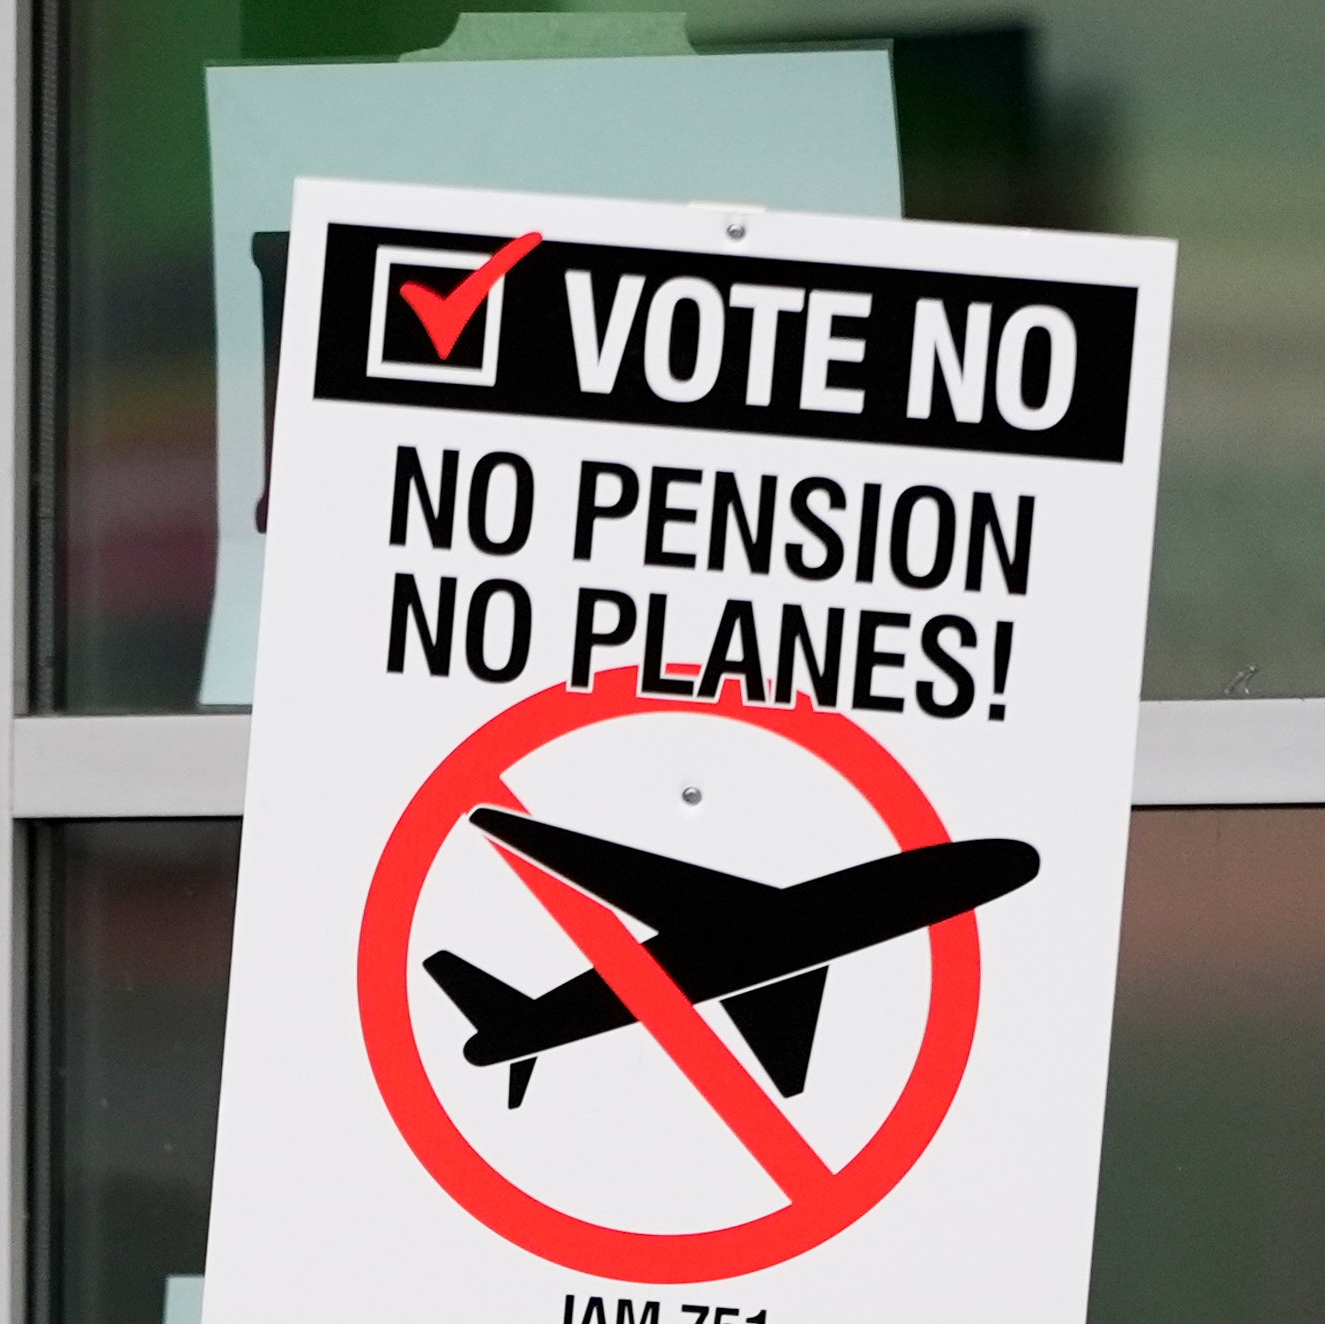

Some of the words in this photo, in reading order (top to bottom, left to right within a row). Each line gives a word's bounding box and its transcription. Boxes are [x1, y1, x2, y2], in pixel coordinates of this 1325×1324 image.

[564, 271, 872, 415] VOTE
[906, 298, 1078, 432] NO
[389, 445, 535, 557] NO
[572, 459, 1036, 597] PENSION
[386, 572, 533, 684] NO
[569, 585, 1015, 723] PLANES!
